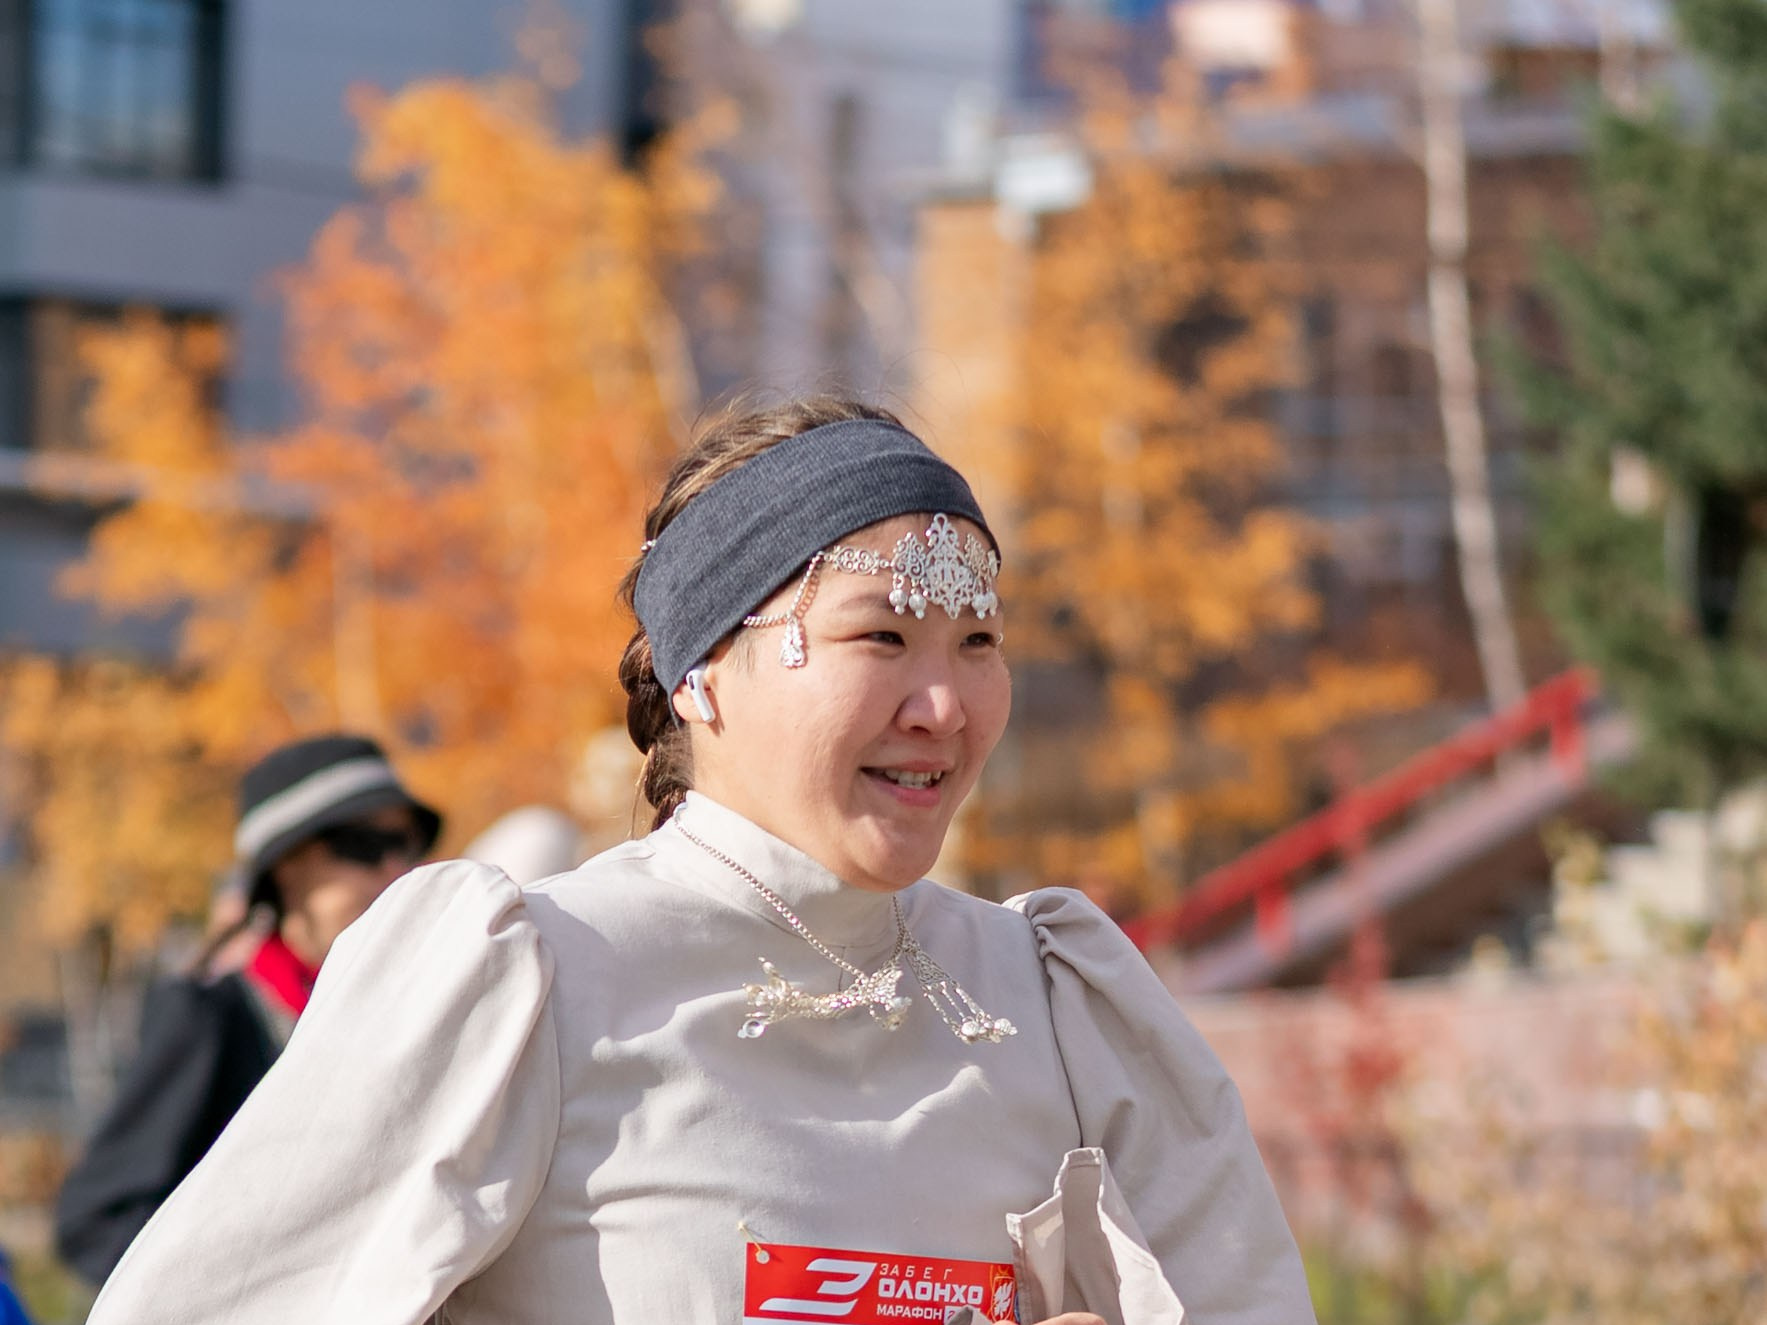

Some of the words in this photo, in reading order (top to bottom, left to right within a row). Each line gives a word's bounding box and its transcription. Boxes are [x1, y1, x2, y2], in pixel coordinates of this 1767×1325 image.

[879, 1263, 953, 1280] ЗАБЕГ
[878, 1278, 984, 1305] ОЛОНХО
[876, 1303, 943, 1320] МАРАФОН
